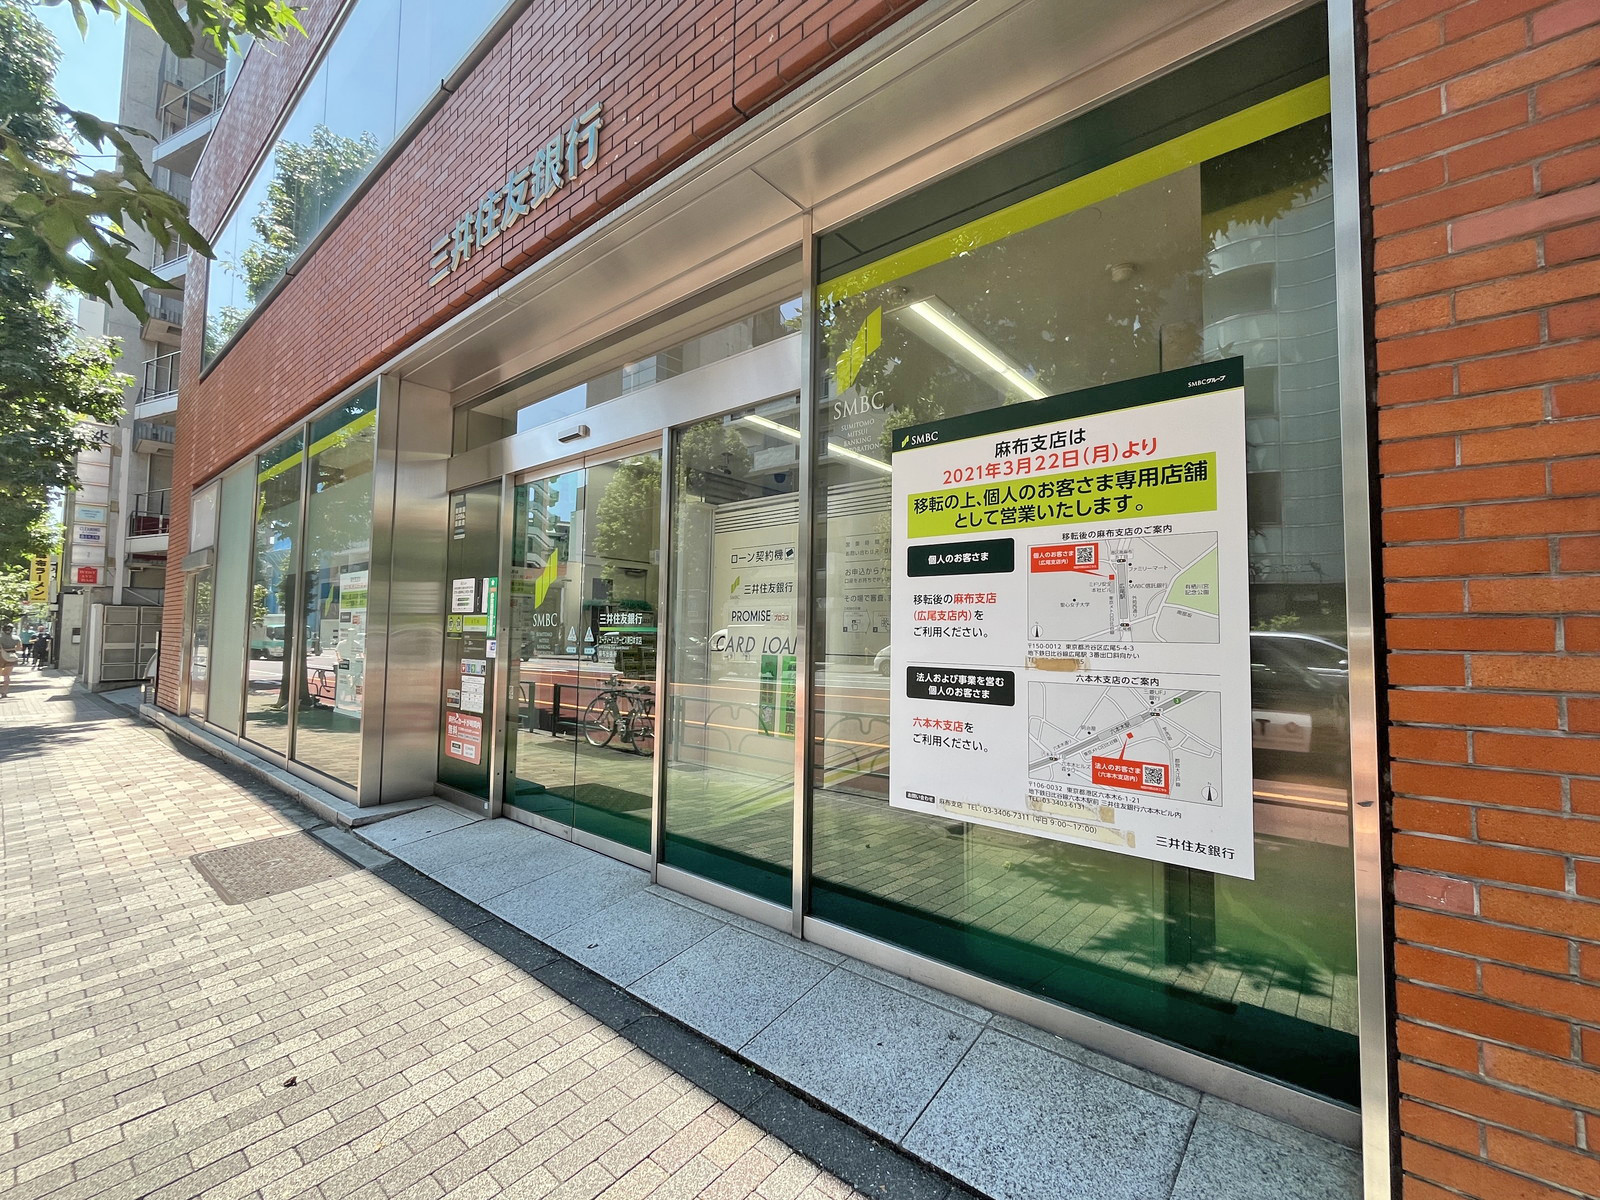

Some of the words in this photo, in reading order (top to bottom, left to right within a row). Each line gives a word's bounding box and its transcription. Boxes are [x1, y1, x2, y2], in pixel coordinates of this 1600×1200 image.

[429, 101, 603, 287] 三井住友銀行
[1187, 375, 1227, 388] SMBCグループ
[833, 391, 885, 420] SMBC
[841, 418, 875, 431] SUMITOMO
[847, 428, 868, 438] MITSUI
[911, 431, 939, 446] SMBC
[843, 436, 872, 447] BANKING
[994, 427, 1087, 459] 麻布支店は
[943, 437, 1158, 485] 2021年3月22日(月)より
[913, 460, 1208, 515] 移転の上、個人のお客さま専用店舗
[954, 494, 1144, 529] として営業いたします。
[1061, 524, 1173, 541] 移転後の麻布支店のご案内
[731, 549, 784, 564] ローン契約機
[927, 552, 989, 565] 個人のお客さま
[1032, 550, 1075, 559] 個人のお客さま
[1128, 565, 1168, 573] ファミリーマート
[743, 581, 794, 595] 三井住友銀行
[913, 592, 997, 606] 移転後の麻布支店
[532, 612, 559, 628] SMBC
[599, 612, 643, 625] 三井住友銀行
[731, 609, 771, 622] PROMISE
[773, 614, 790, 622] プロミス
[913, 609, 984, 622] (広尾支店内)を
[913, 626, 989, 639] ご利用ください。
[716, 635, 756, 653] CARD
[916, 672, 1005, 687] 法人および事業を営む
[1075, 674, 1160, 687] 六本木支店のご案内
[928, 685, 991, 699] 個人のお客さま
[912, 717, 974, 733] 六本木支店を
[912, 733, 989, 753] ご利用ください。
[1094, 762, 1142, 775] 法人のお客さま
[1097, 772, 1139, 783] (六本木支店内)
[1028, 781, 1063, 792] 〒106-0032
[1066, 787, 1140, 804] 東京都港区六本木6-1-21
[1101, 800, 1182, 819] 三井住友銀行六本木ビル内
[1155, 835, 1236, 860] 三井住友銀行
